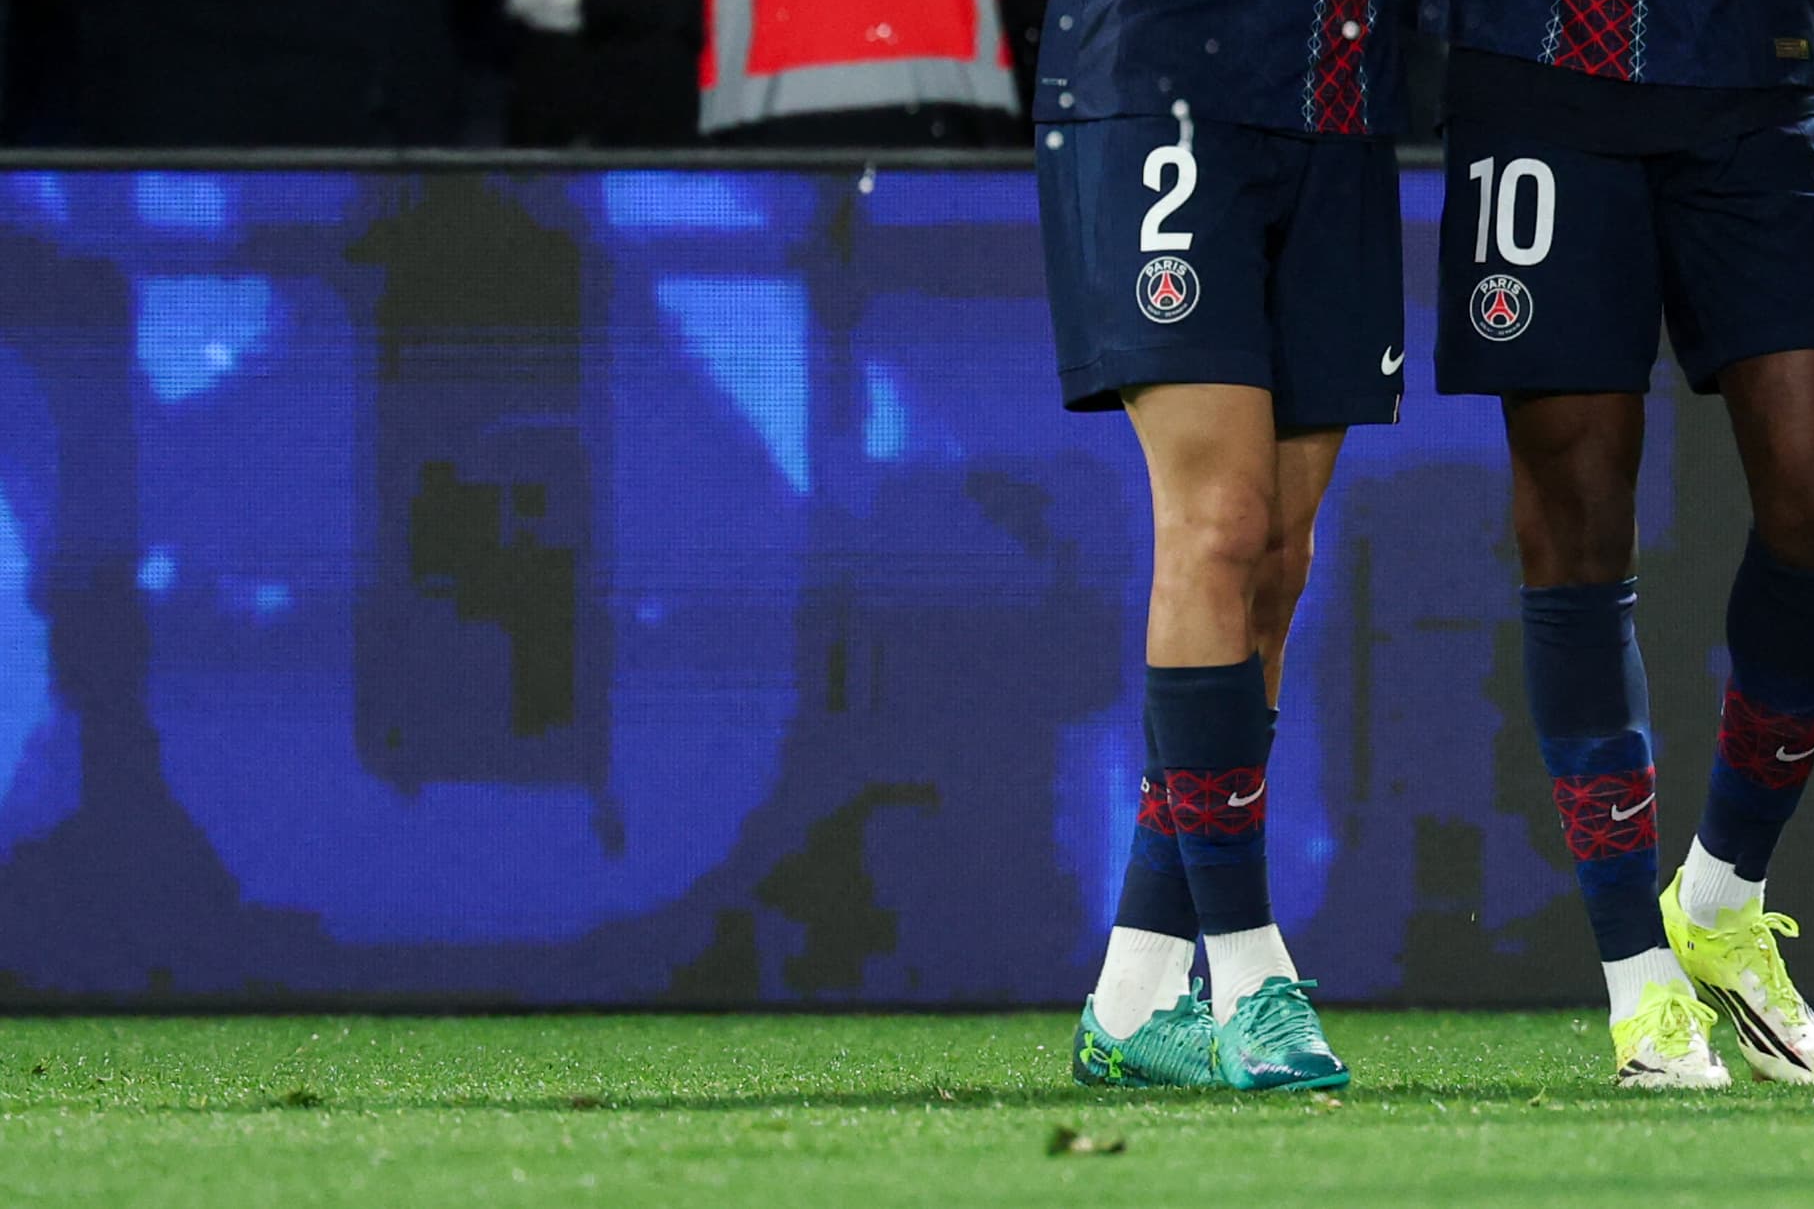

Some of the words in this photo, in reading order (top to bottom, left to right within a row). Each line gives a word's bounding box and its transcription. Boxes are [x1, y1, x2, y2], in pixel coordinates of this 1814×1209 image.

[1140, 145, 1197, 252] 2
[1469, 156, 1556, 266] 10
[1145, 260, 1187, 277] PARIS
[1480, 278, 1521, 294] PARIS
